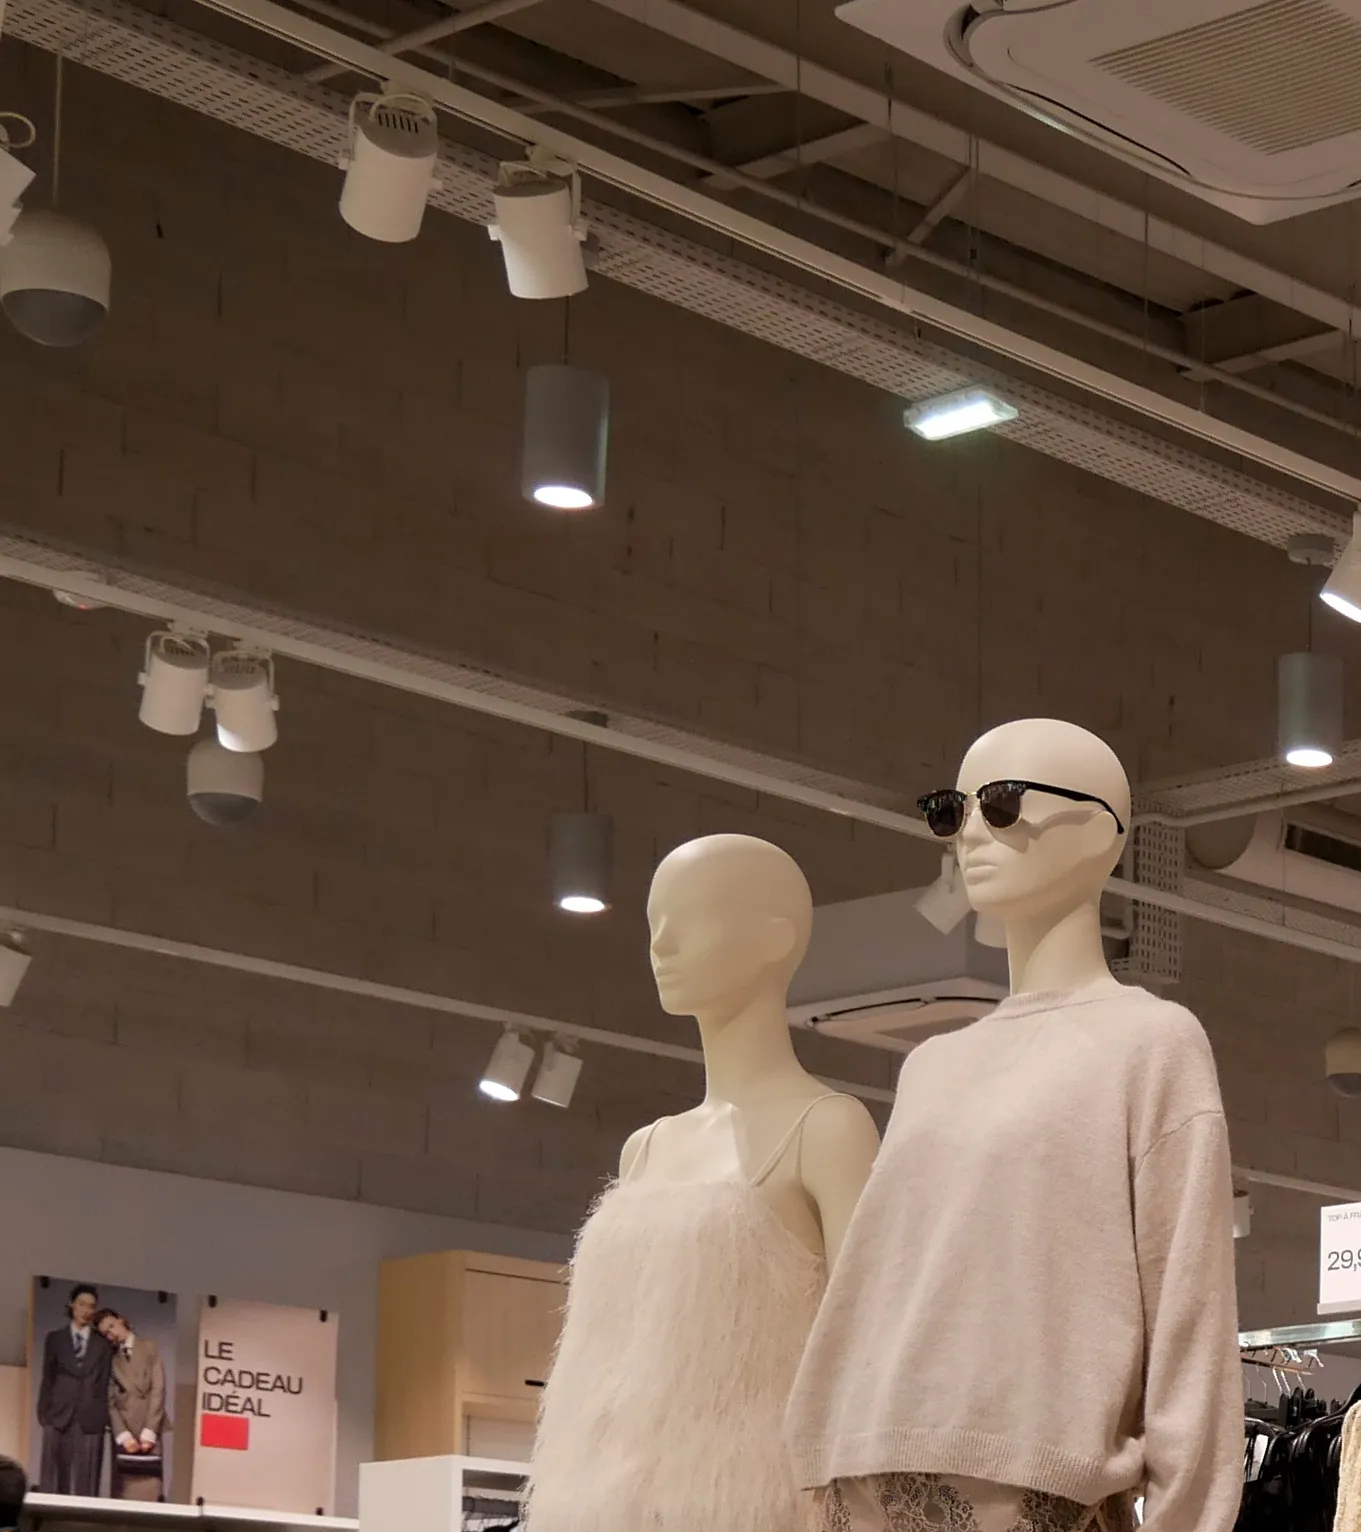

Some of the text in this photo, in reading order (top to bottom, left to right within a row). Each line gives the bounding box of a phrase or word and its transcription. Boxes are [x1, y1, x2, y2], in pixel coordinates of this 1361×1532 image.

[203, 1339, 235, 1361] LE
[203, 1366, 303, 1395] CADEAU
[202, 1390, 271, 1418] IDÉAL
